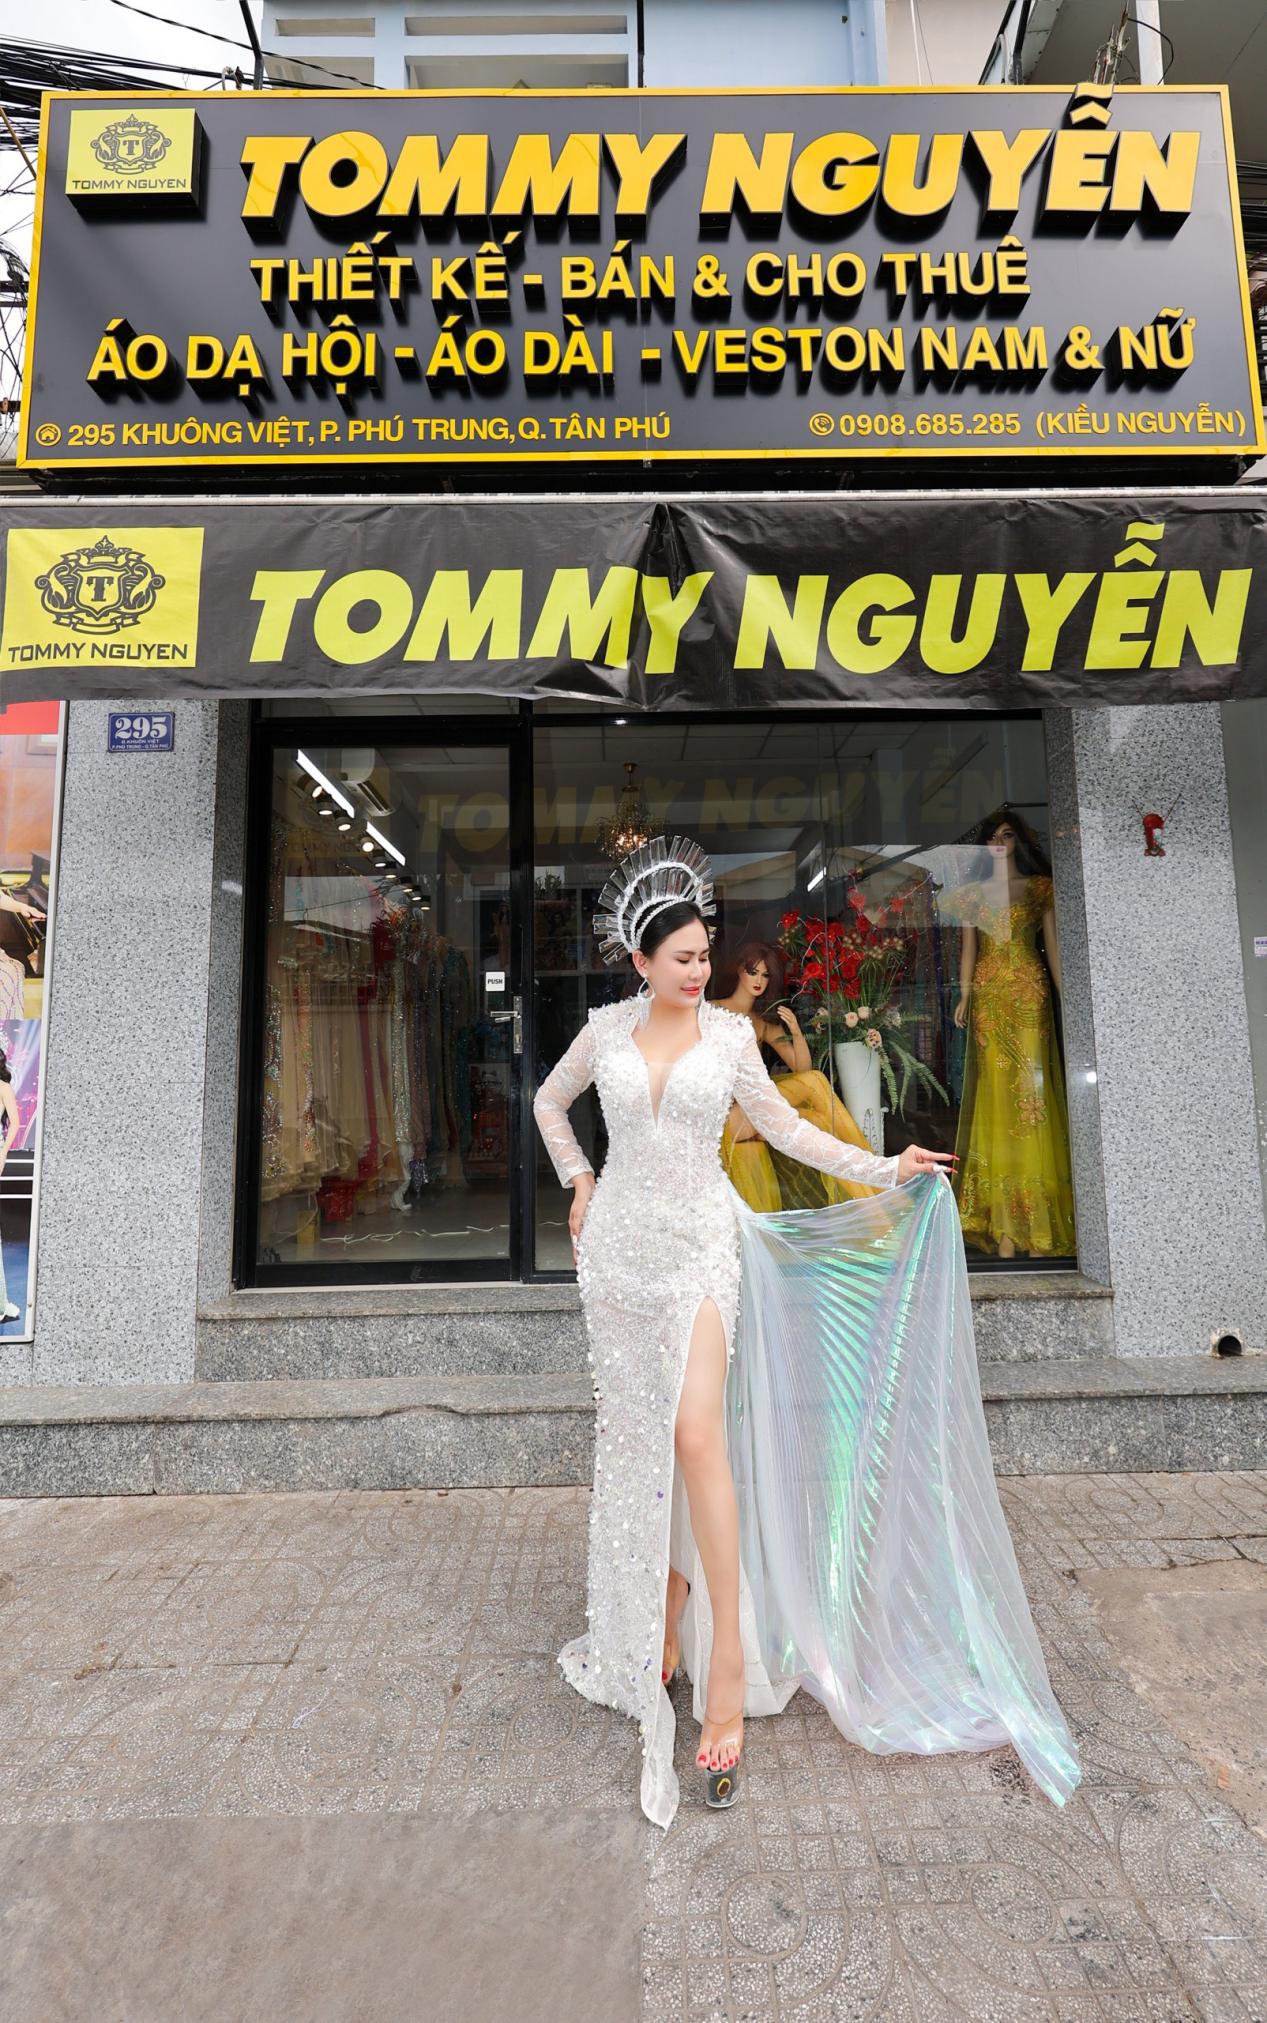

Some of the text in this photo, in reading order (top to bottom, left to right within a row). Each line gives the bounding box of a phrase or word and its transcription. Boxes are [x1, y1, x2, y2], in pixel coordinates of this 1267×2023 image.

[241, 82, 1201, 217] TOMMY NGUYỄN
[72, 178, 187, 190] TOMMY NGUYEN
[250, 231, 413, 302] THIẾT
[432, 231, 520, 300] KẾ
[561, 240, 675, 299] BÁN
[693, 254, 730, 298] &
[746, 252, 867, 297] CHO
[883, 235, 1031, 295] THUÊ
[87, 318, 168, 380] ÁO
[187, 335, 263, 396] DẠ
[283, 315, 376, 395] HỘI
[427, 315, 506, 376] ÁO
[524, 315, 613, 375] DÀI
[674, 326, 905, 373] VESTON
[922, 326, 1048, 370] NAM
[1065, 325, 1103, 369] &
[1120, 308, 1197, 369] NỮ
[68, 424, 115, 446] 295
[122, 417, 242, 445] KHUÔNG
[247, 416, 315, 448] VIỆT,
[320, 421, 341, 442] P.
[349, 415, 404, 442] PHÚ
[550, 413, 606, 440] TÂN
[615, 412, 670, 438] PHÚ
[840, 402, 1246, 438] 0908.685.285 (KIỀU NGUYỄN)
[250, 522, 1253, 674] TOMMY NGUYỄN
[8, 643, 188, 663] TOMMY NGUYEN
[115, 717, 168, 739] 295
